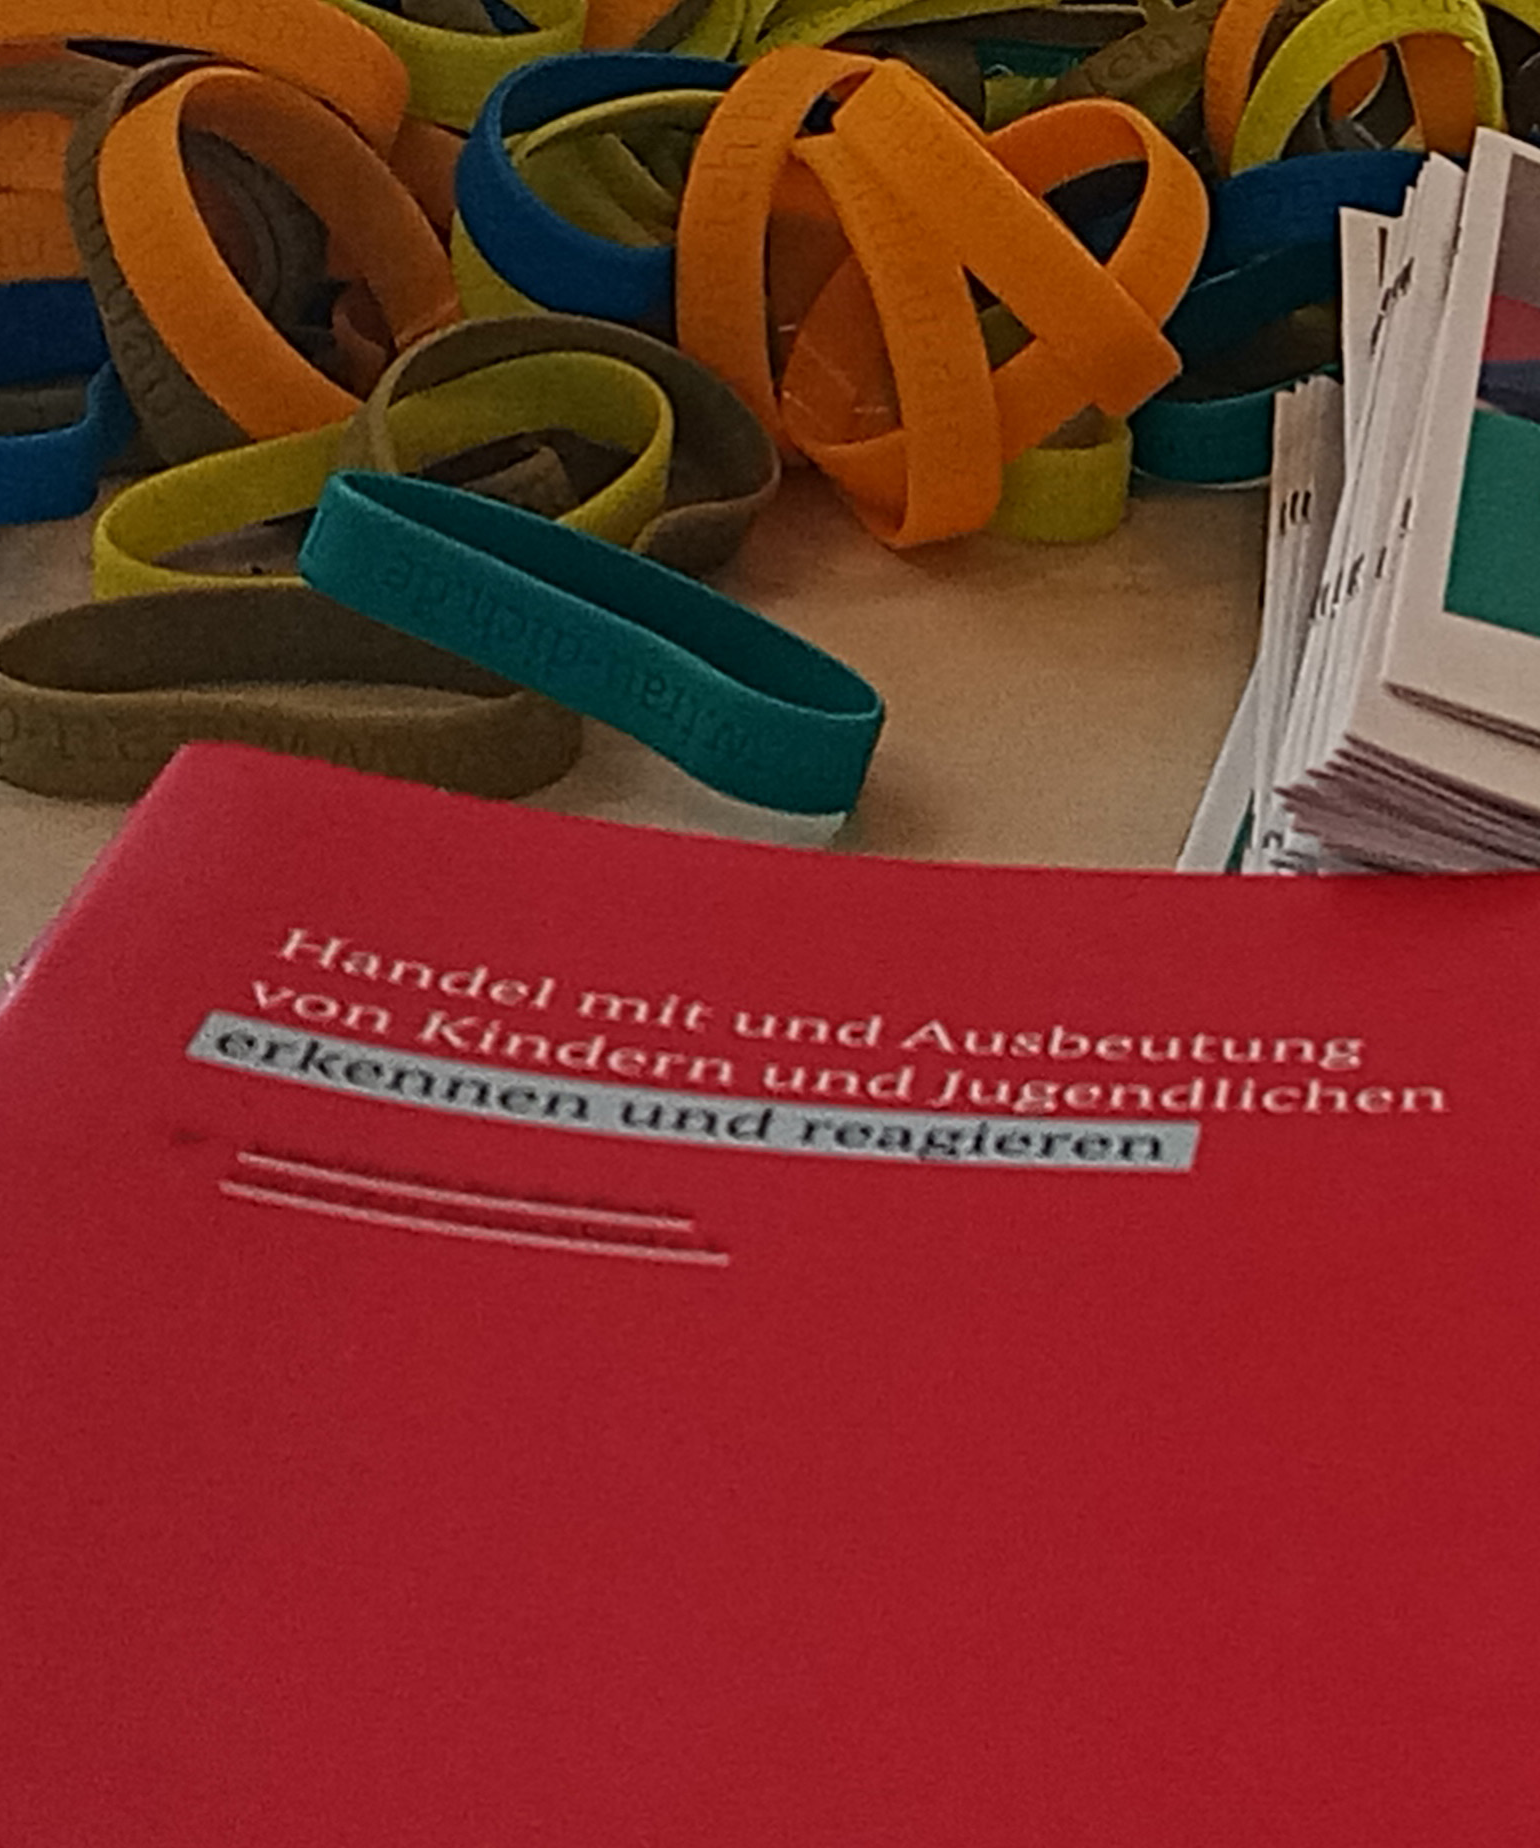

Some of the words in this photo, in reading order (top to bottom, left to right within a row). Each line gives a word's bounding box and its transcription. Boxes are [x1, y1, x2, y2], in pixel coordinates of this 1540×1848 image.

[250, 980, 395, 1036] von
[415, 1008, 736, 1089] Kindern
[762, 1063, 914, 1102] und
[930, 1067, 1450, 1115] Jugendlichen
[277, 928, 556, 1011] Handel
[576, 985, 716, 1035] mit
[733, 1010, 884, 1050] und
[901, 1018, 1365, 1071] Ausbeutung
[212, 1028, 592, 1124] erkennen
[617, 1098, 775, 1144] und
[801, 1115, 1163, 1164] reagieren
